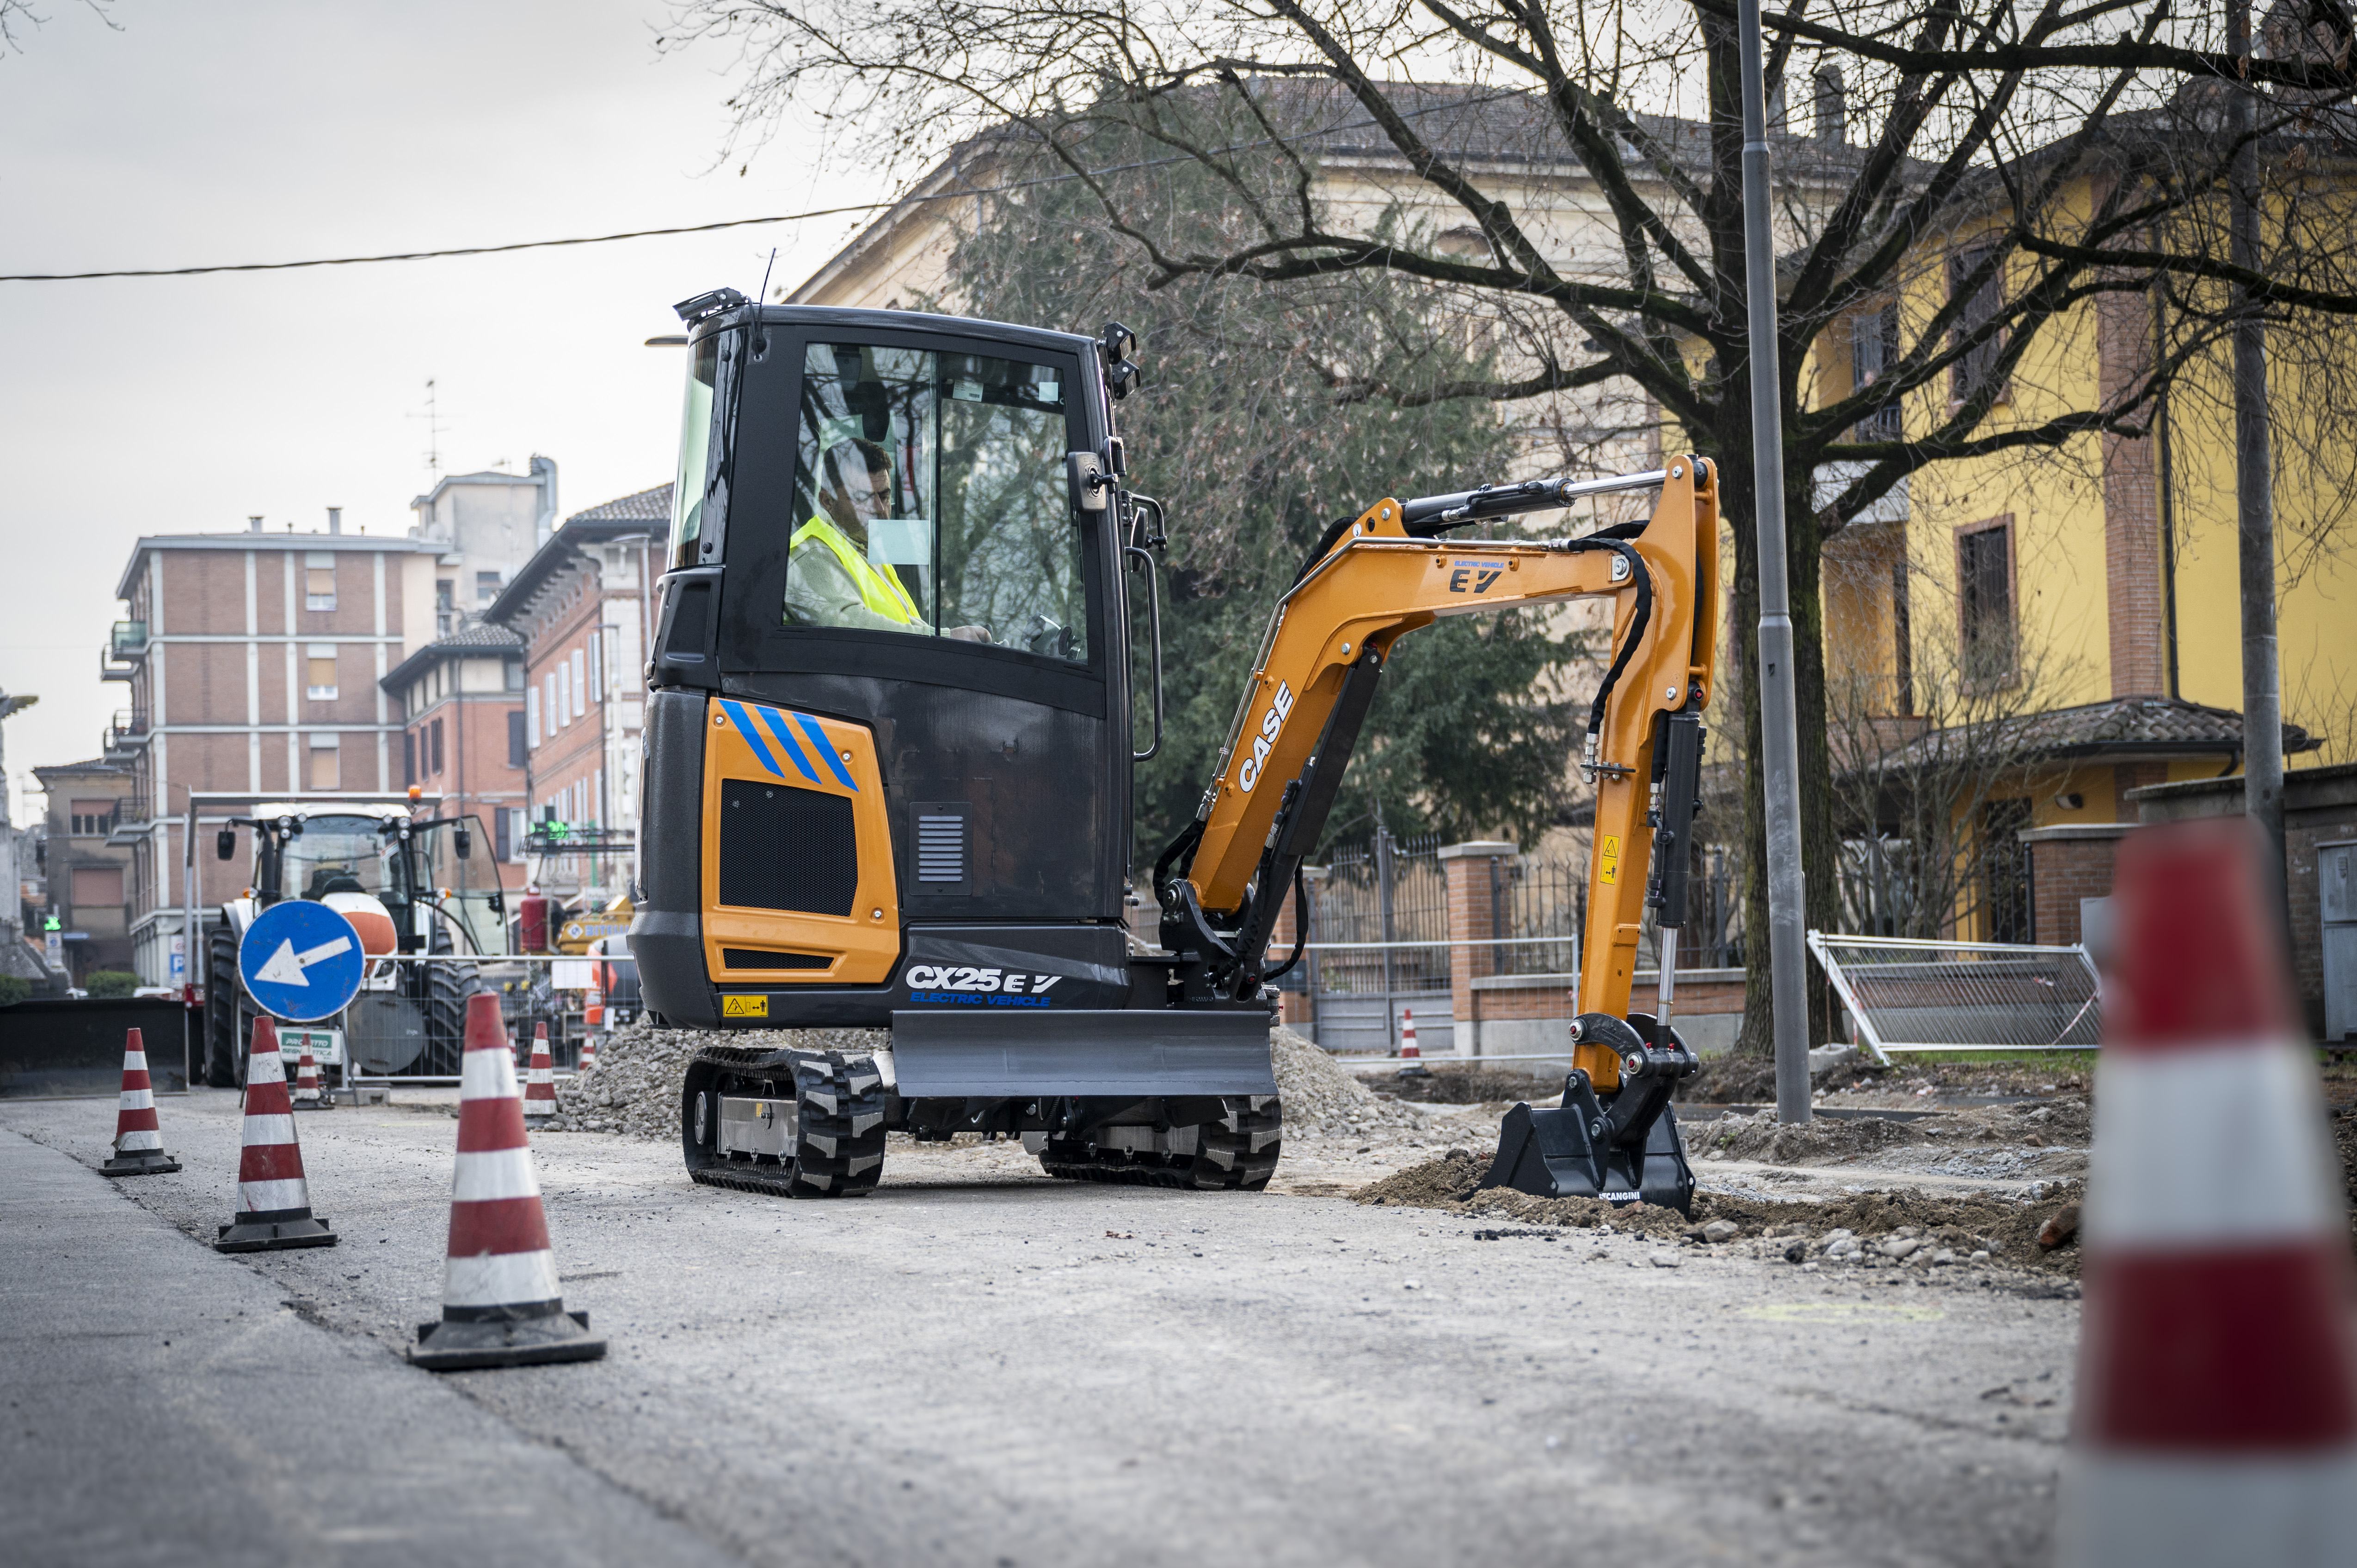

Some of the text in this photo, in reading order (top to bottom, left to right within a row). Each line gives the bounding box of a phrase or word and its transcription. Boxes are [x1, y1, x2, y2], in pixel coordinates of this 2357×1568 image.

[1239, 679, 1294, 793] CASE
[906, 965, 1001, 991] CX25
[910, 992, 1051, 1007] ELECTRIC VEHICLE
[1606, 1192, 1640, 1200] CANGINI
